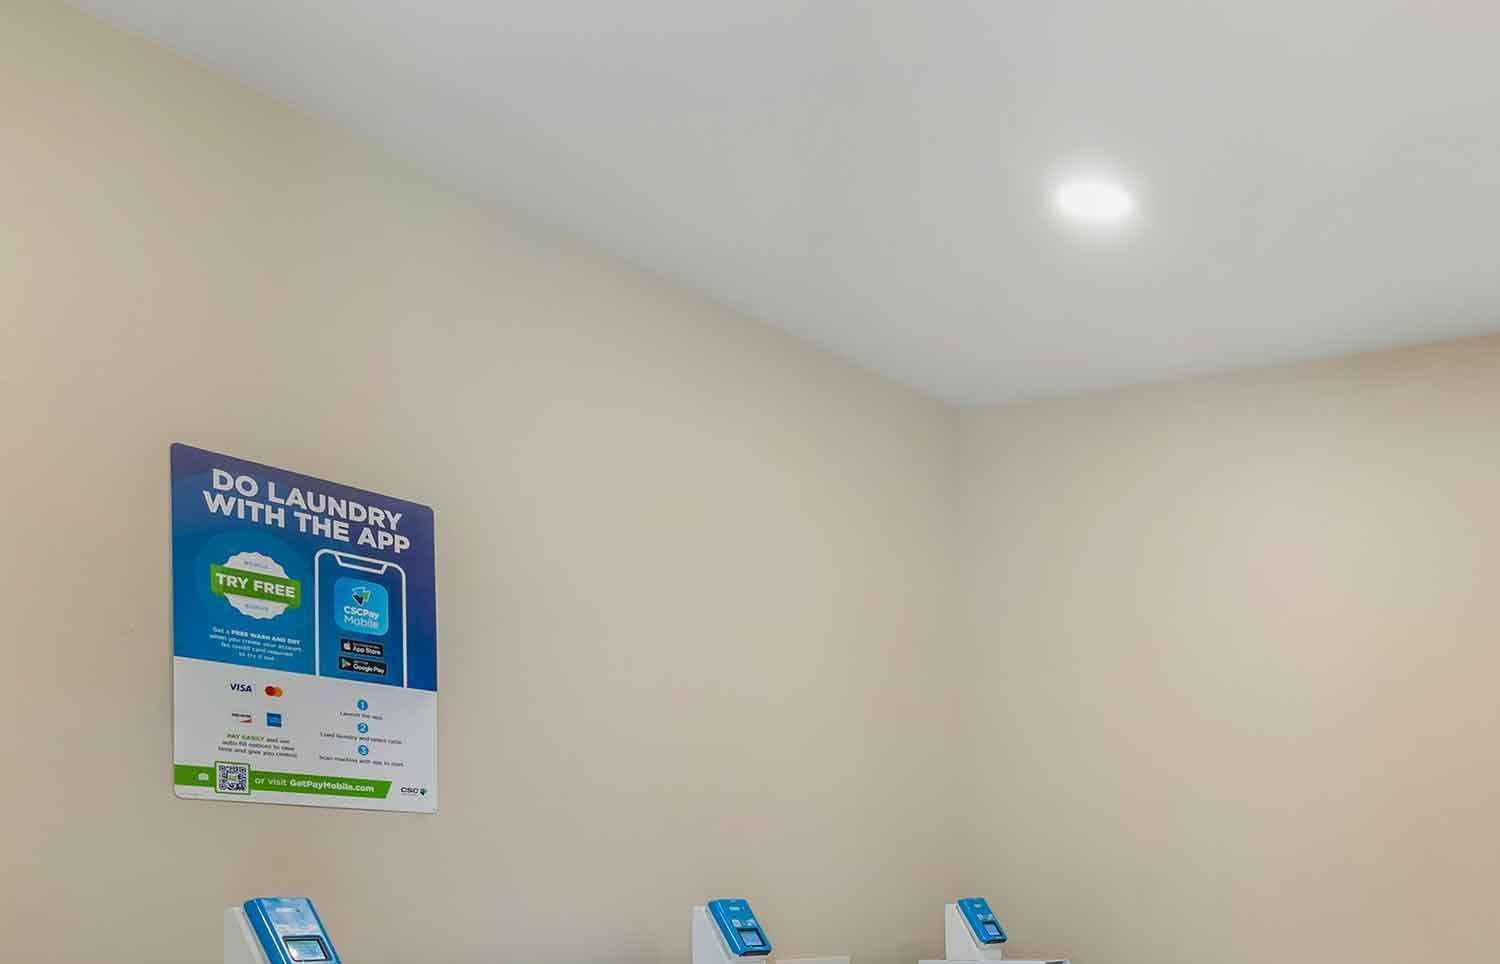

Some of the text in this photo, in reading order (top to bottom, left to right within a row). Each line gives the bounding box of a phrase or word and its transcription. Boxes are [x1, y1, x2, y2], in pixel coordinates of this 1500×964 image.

[212, 468, 403, 530] DO LAUNDRY
[203, 490, 410, 554] WITH THE APP
[216, 573, 295, 598] TRY FREE
[344, 606, 379, 620] CSCPay
[344, 615, 379, 628] Mobile
[365, 647, 381, 655] Store
[353, 664, 385, 674] Google Play
[230, 683, 252, 693] VISA
[268, 776, 288, 787] visit
[289, 779, 375, 794] GetPayMobile.com
[400, 786, 420, 795] CSC
